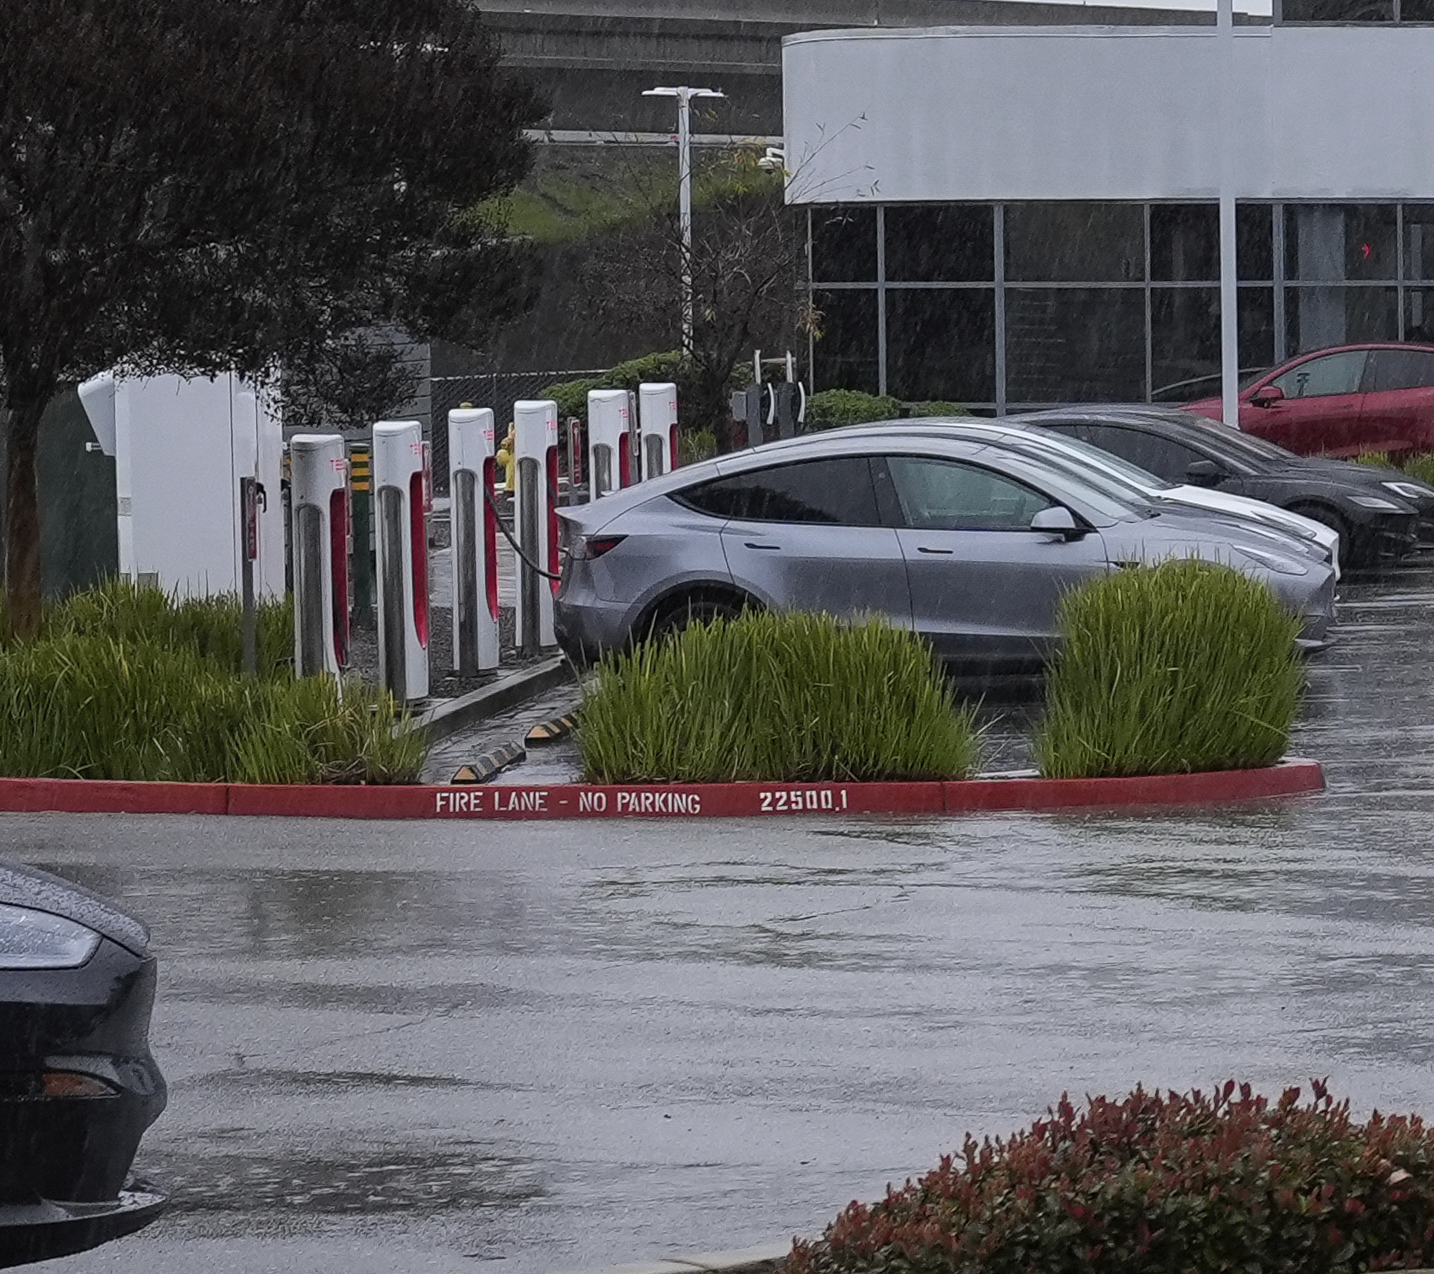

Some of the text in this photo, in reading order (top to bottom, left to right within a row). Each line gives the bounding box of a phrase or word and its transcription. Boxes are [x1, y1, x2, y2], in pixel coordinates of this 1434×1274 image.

[436, 791, 484, 812] FIRE
[494, 791, 548, 812] LANE
[579, 791, 607, 812] NO
[617, 791, 701, 814] PARKING
[759, 789, 848, 812] 22500.1
